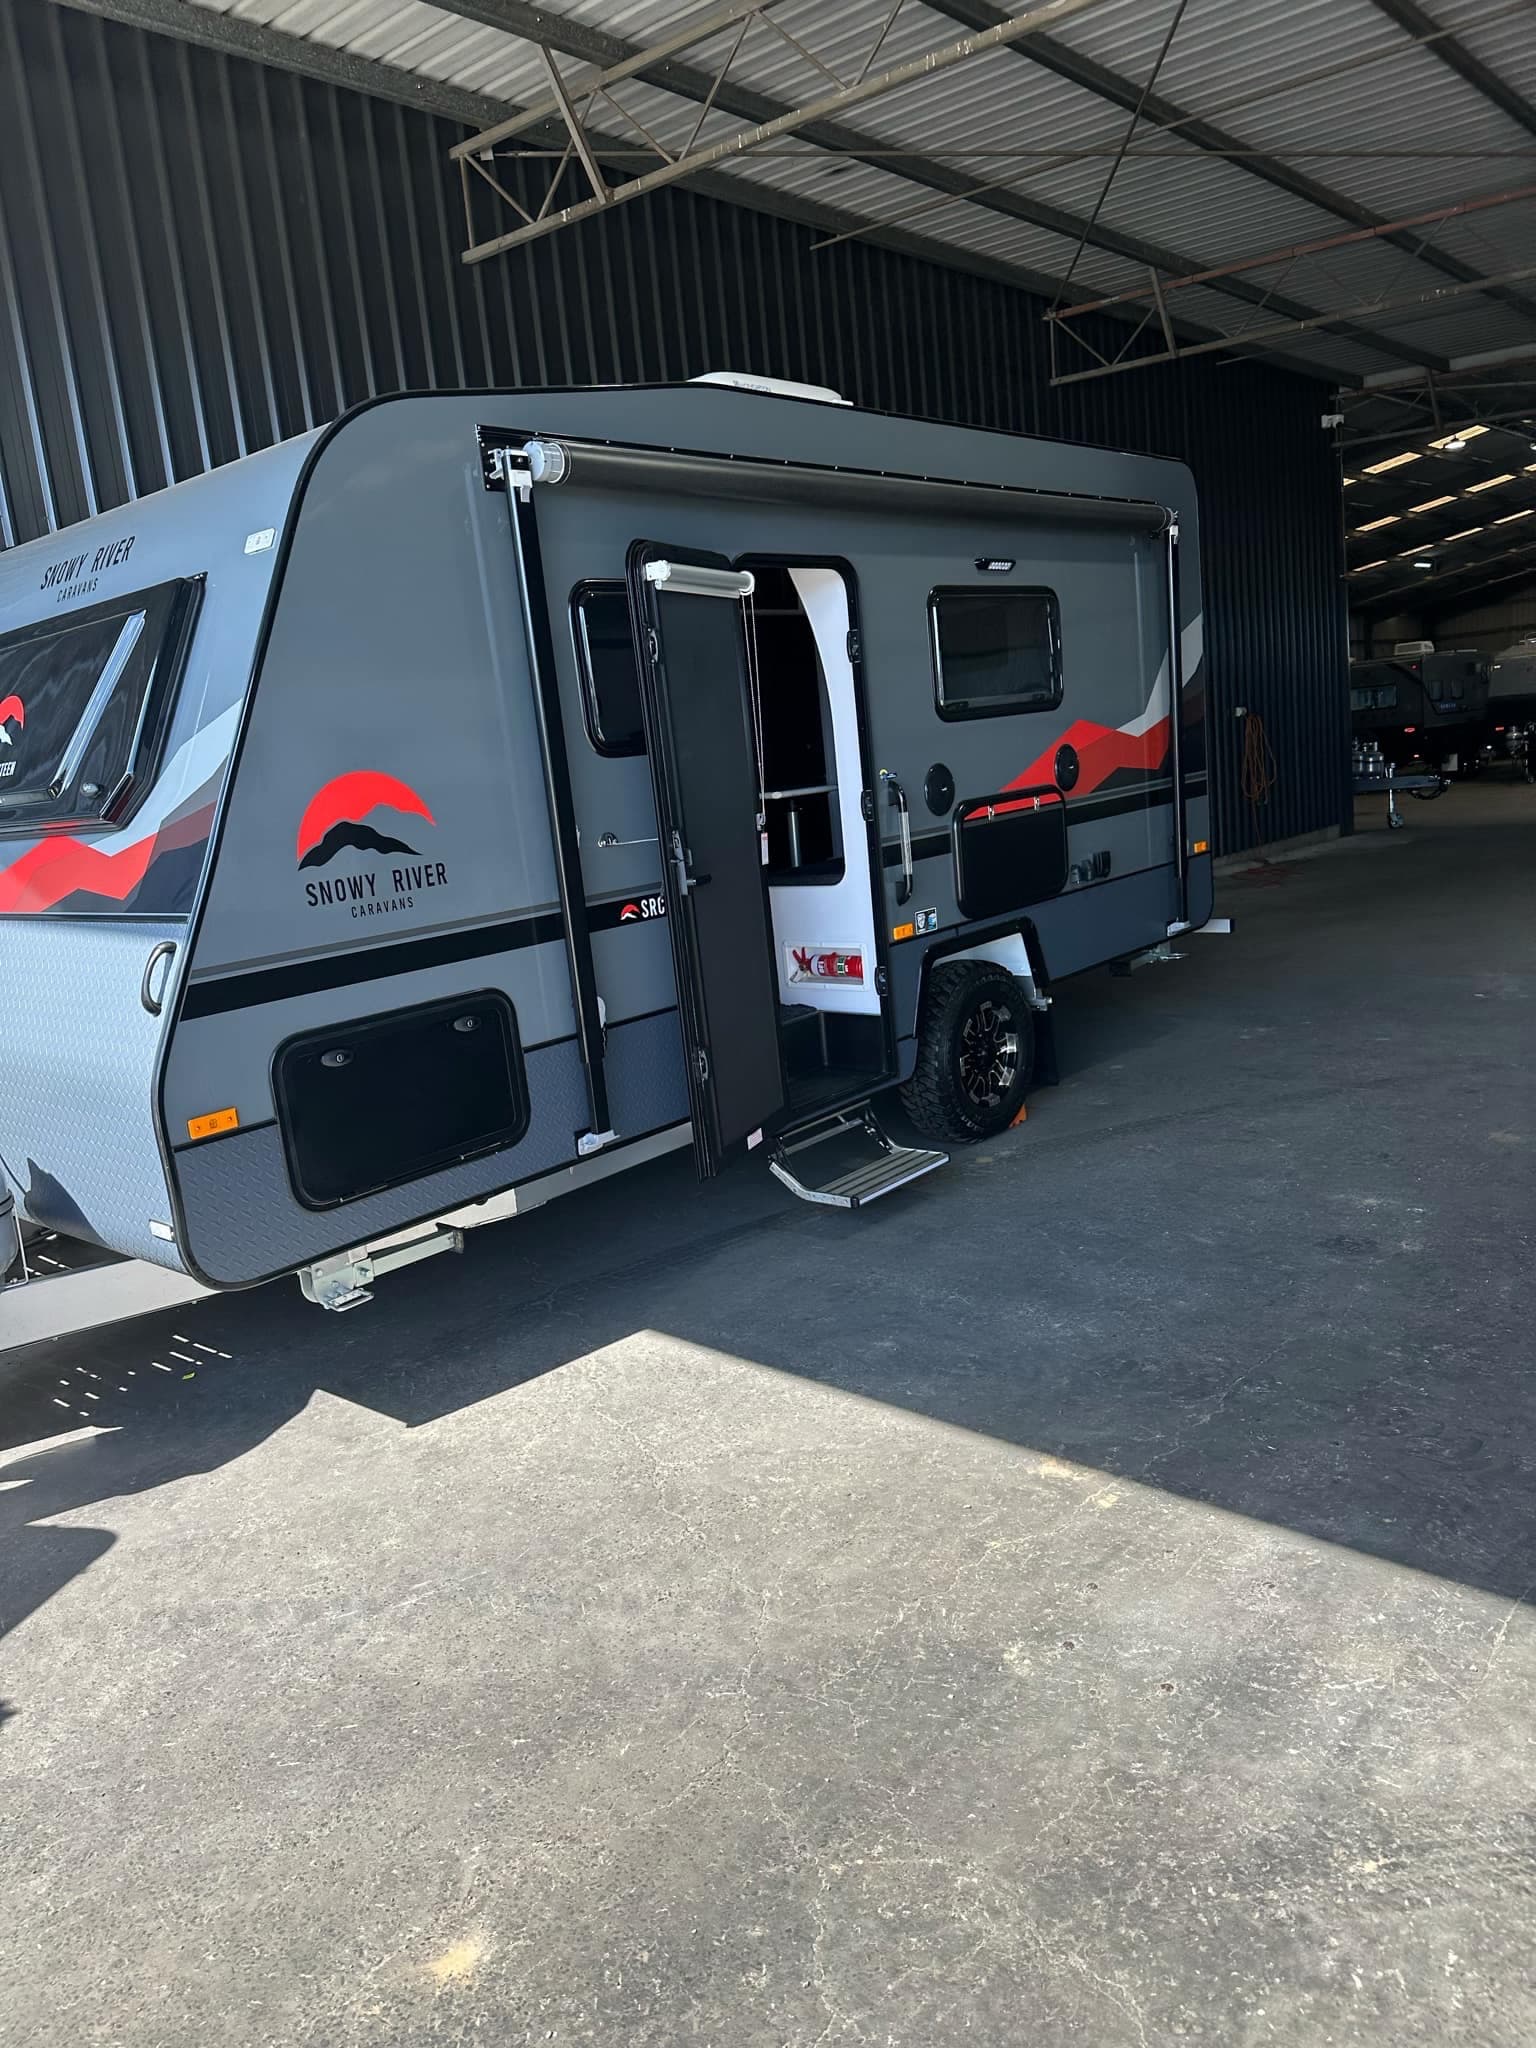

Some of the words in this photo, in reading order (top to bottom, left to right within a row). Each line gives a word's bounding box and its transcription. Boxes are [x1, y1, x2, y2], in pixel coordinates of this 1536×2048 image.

[40, 552, 89, 590] SNOWY
[91, 536, 135, 573] RIVER
[57, 577, 99, 603] CARAVANS
[305, 873, 376, 907] SNOWY
[392, 862, 448, 893] RIVER
[351, 896, 414, 919] CARAVANS
[641, 895, 665, 918] SRC
